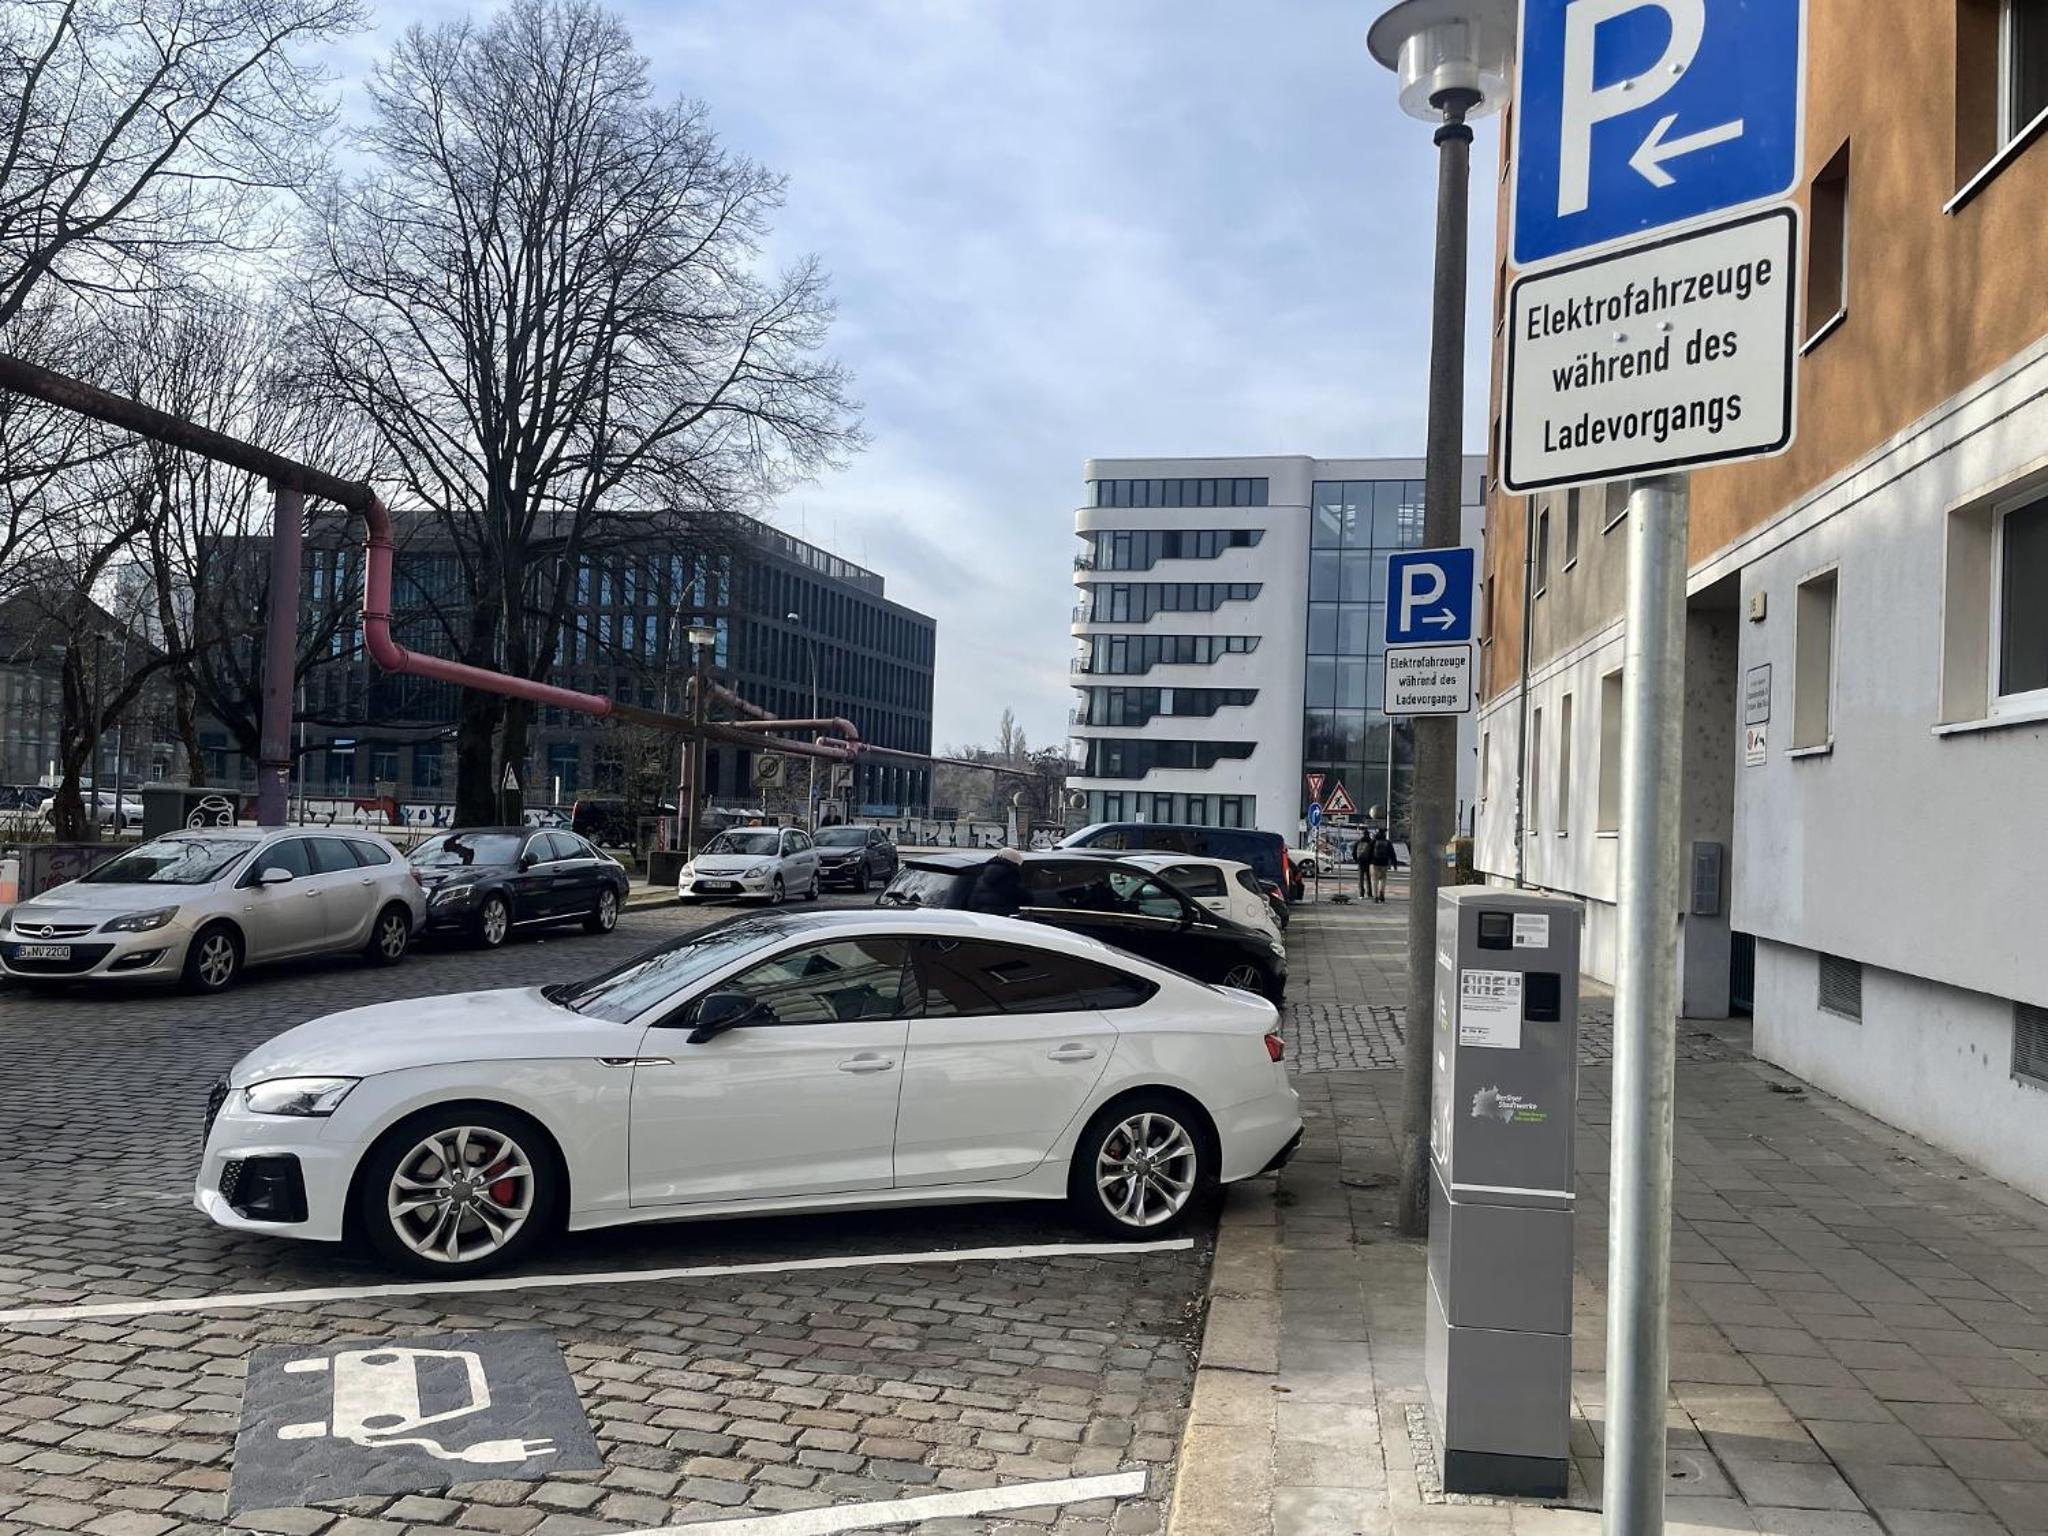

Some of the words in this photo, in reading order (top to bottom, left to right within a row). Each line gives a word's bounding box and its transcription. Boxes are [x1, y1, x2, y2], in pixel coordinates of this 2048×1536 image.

[1557, 1, 1707, 218] P
[1526, 257, 1773, 341] Elektrofahrzeuge
[1552, 336, 1671, 393] während
[1686, 329, 1738, 366] des
[1544, 391, 1742, 454] Ladevorgangs
[1400, 563, 1446, 632] P
[1390, 656, 1466, 669] Elektrofahrzeuge
[1399, 674, 1436, 686] während
[1440, 674, 1456, 685] des
[1396, 693, 1458, 706] Ladevorgangs
